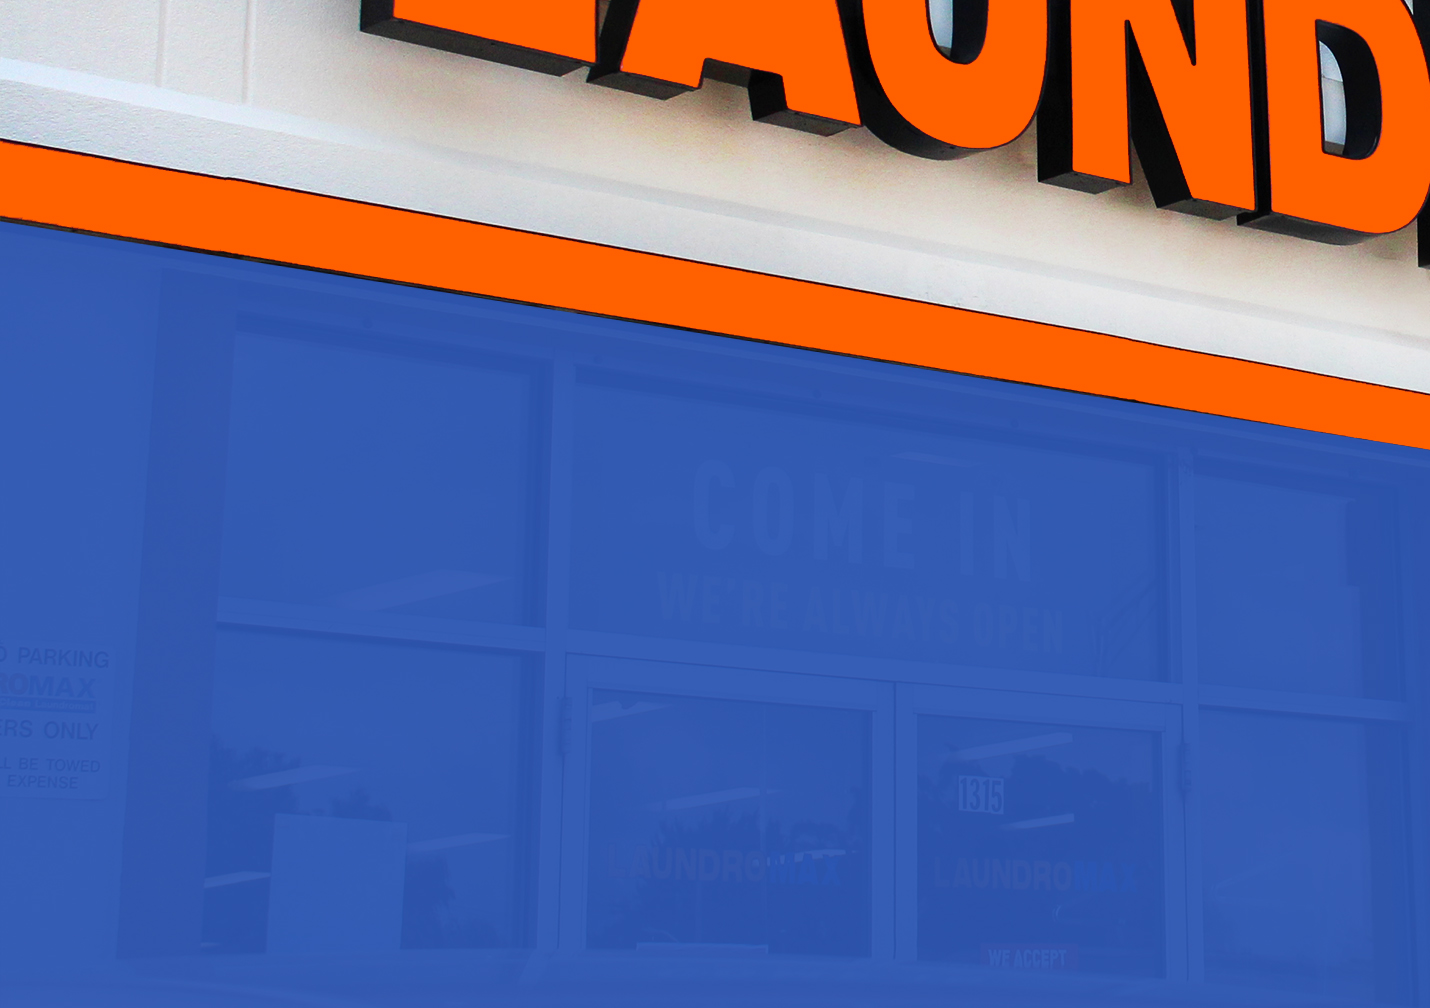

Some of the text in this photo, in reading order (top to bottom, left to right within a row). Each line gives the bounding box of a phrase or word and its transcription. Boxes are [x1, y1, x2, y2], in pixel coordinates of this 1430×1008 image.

[692, 458, 1032, 582] COME IN
[656, 570, 1063, 654] WE'RE ALWAYS OPEN
[17, 646, 110, 669] PARKING
[0, 718, 99, 740] RS ONLY
[18, 757, 39, 770] BE
[46, 758, 101, 773] TOWED
[7, 774, 79, 789] EXPENSE
[959, 776, 1003, 813] 1315
[606, 842, 843, 886] LAUNDROMAX
[932, 856, 1139, 893] LAUNDROMAX
[1013, 948, 1068, 969] ACCEPT
